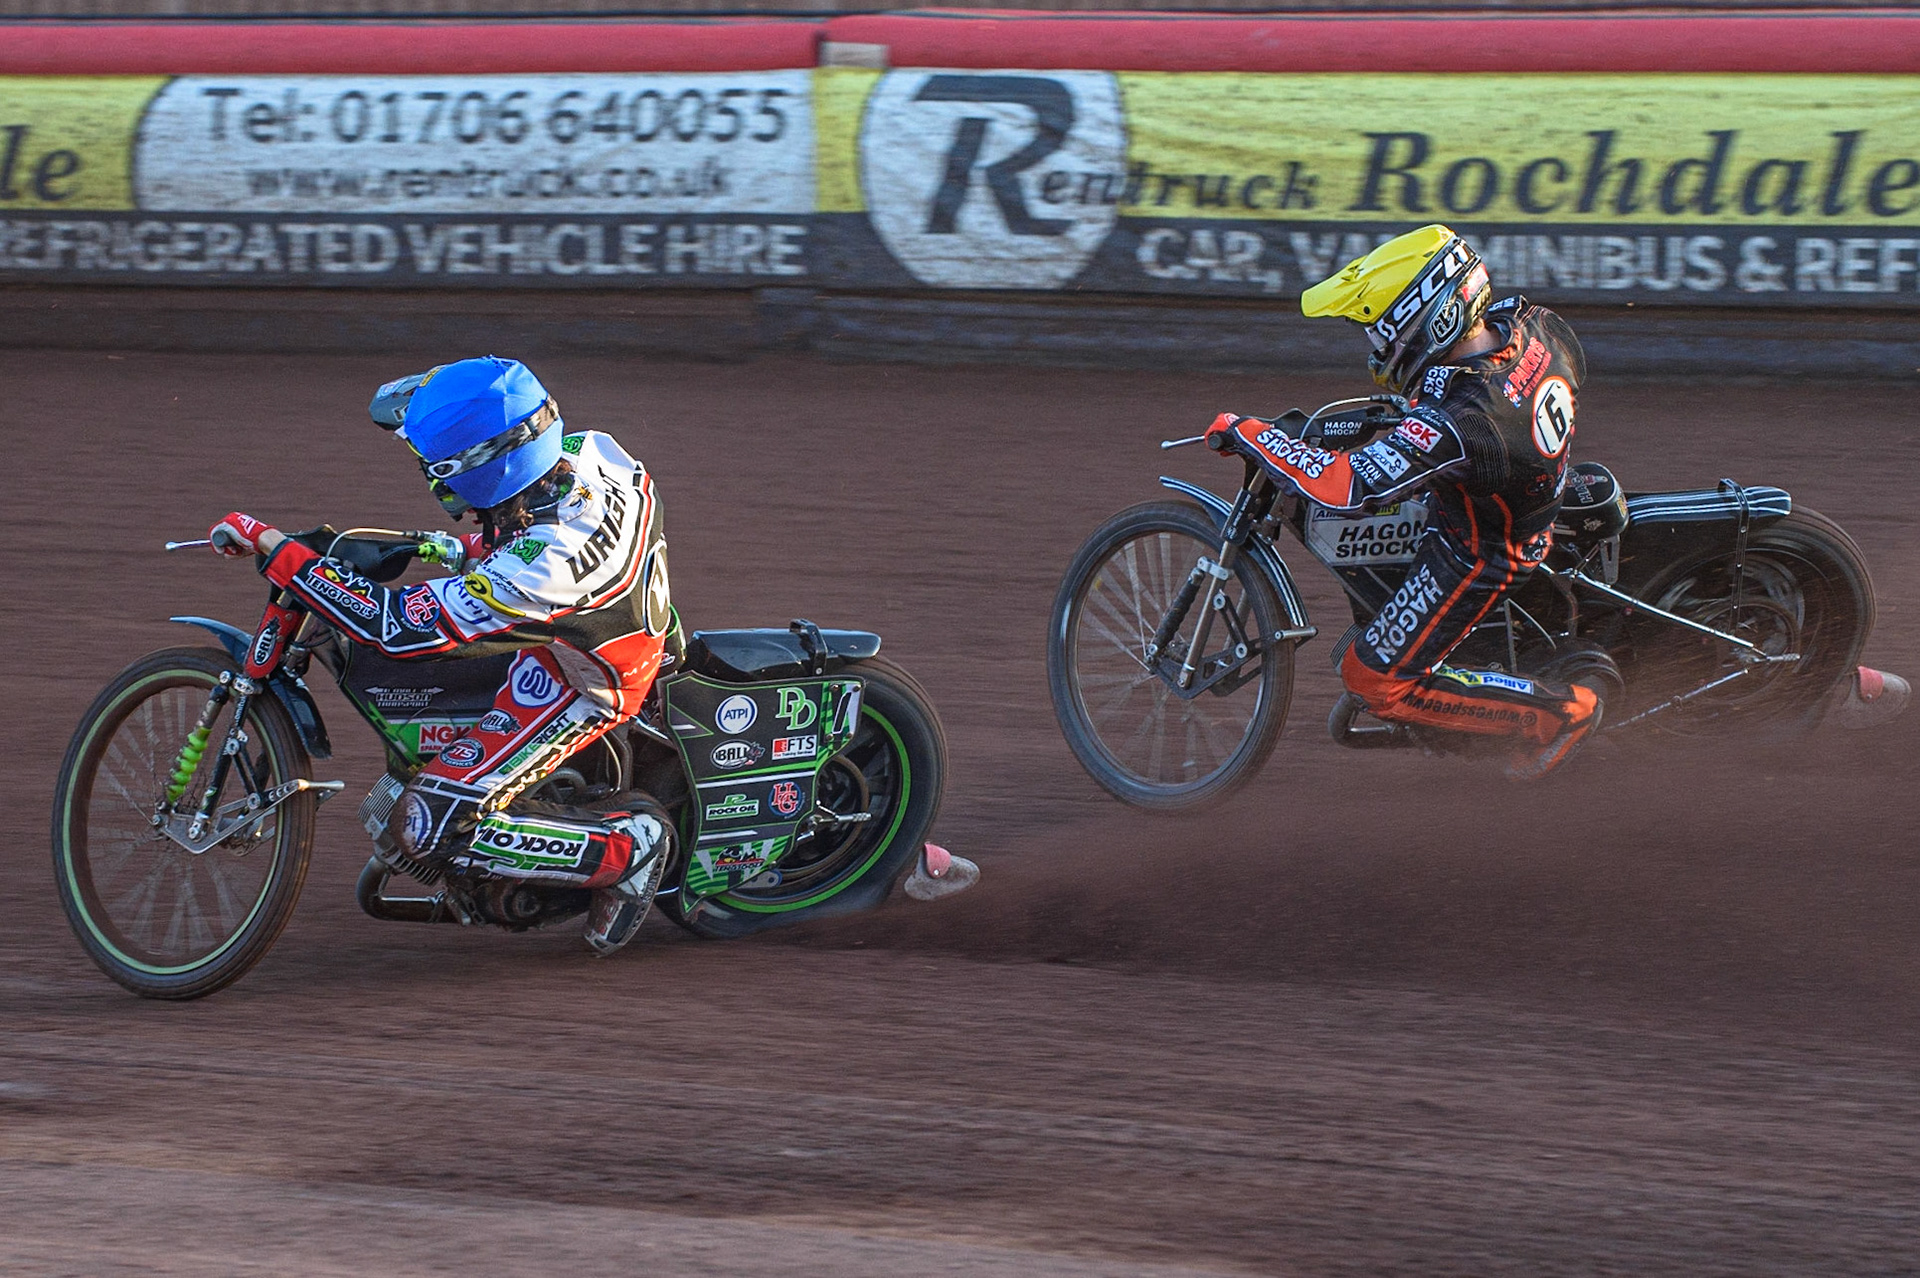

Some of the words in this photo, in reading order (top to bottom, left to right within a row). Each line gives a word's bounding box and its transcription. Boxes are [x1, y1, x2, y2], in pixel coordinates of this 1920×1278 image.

[204, 88, 316, 143] Tel:
[330, 90, 529, 143] 01706
[546, 88, 790, 143] 640055
[1347, 128, 1920, 217] Rochdale
[0, 220, 399, 274] EFRIGERATED
[403, 223, 656, 275] VEHICLE
[664, 224, 808, 275] HIRE
[1289, 232, 1398, 284] VA
[1736, 236, 1790, 292] &
[1795, 238, 1920, 292] REF
[1423, 366, 1440, 394] CKS
[1324, 421, 1363, 429] HAGON
[1256, 430, 1324, 479] SHOCKS
[565, 465, 626, 584] WRIGHT
[1338, 520, 1425, 542] HAGON
[1335, 539, 1422, 559] SHOCK
[1365, 563, 1430, 646] SHOCKS
[1375, 576, 1444, 664] HAGON
[1482, 676, 1529, 691] Allied
[723, 708, 749, 721] ATPI
[421, 725, 472, 744] NGK
[787, 736, 815, 751] FTS
[708, 805, 738, 816] ROCK
[739, 804, 757, 812] OIL
[514, 834, 583, 857] ROCK
